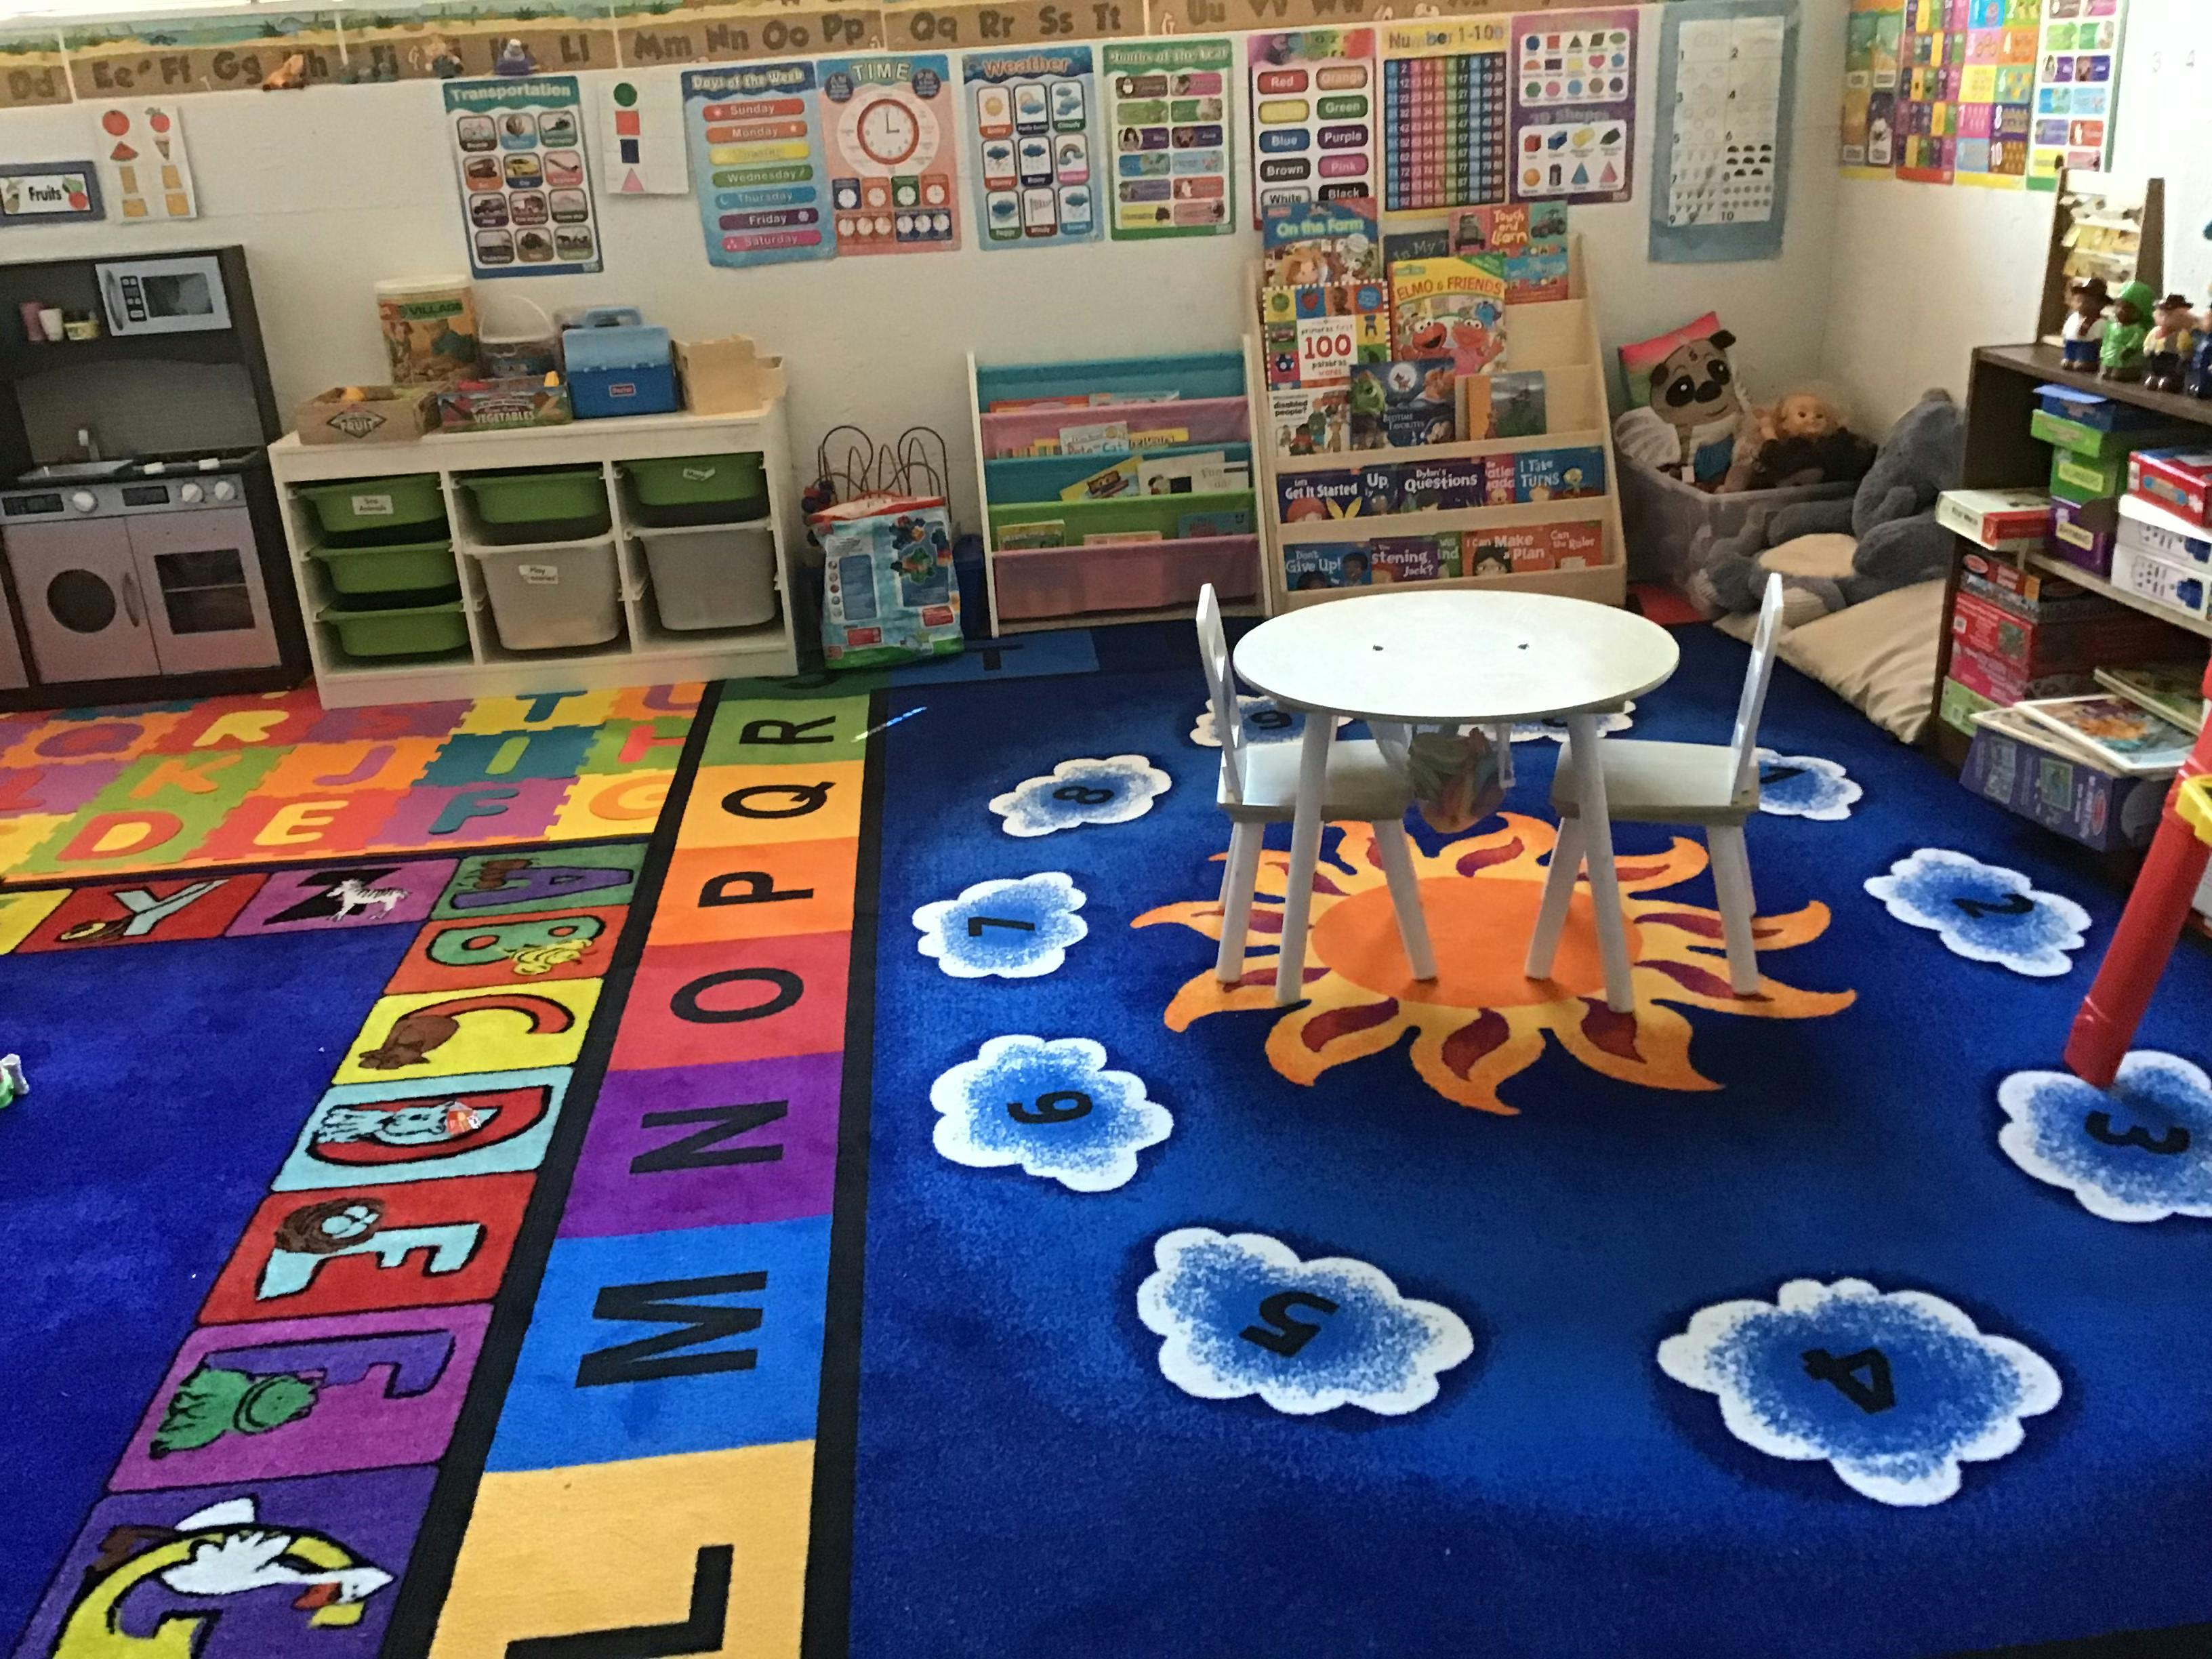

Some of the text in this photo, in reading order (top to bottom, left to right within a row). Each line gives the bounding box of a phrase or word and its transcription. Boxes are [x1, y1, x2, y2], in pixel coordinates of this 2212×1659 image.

[910, 12, 959, 43] Qq
[979, 9, 1014, 40] Rr
[1038, 5, 1074, 35] Ss
[634, 12, 865, 61] Mm Nn Oo Pp
[91, 60, 134, 89] Ee
[212, 50, 262, 85] Gg
[851, 63, 911, 81] TIME
[983, 57, 1071, 77] Weather
[693, 68, 804, 89] Days of the Week
[1271, 76, 1294, 87] Red
[1322, 73, 1365, 85] Orange
[451, 83, 571, 101] Transportation
[730, 104, 775, 116] Sunday
[1325, 102, 1361, 113] Green
[732, 126, 779, 138] Monday
[1324, 131, 1363, 144] Purple
[1271, 136, 1298, 147] Blue
[1267, 165, 1304, 177] Brown
[1330, 161, 1356, 173] Pink
[726, 170, 796, 183] Wednesday
[28, 185, 62, 202] Fruits
[738, 192, 793, 203] Thursday
[1269, 193, 1302, 204] White
[1328, 186, 1360, 199] Black
[749, 213, 787, 226] Friday
[1494, 209, 1525, 223] Touch
[1721, 211, 1734, 222] 10
[1277, 218, 1364, 237] On the Farm
[1498, 221, 1519, 231] and
[745, 234, 798, 247] Saturday
[1414, 240, 1437, 255] My
[1397, 280, 1433, 301] ELMO
[1447, 276, 1503, 295] FRIENDS
[1304, 333, 1351, 360] 100
[1312, 359, 1347, 370] palabras
[474, 411, 535, 425] VEGETABLES
[1275, 407, 1307, 417] people?
[340, 417, 375, 432] FRUIT
[1520, 460, 1524, 473] I
[1285, 487, 1304, 499] Get
[1307, 485, 1315, 497] It
[1317, 483, 1358, 498] Started
[1404, 474, 1478, 494] Questions
[1472, 537, 1491, 547] Can
[1494, 534, 1534, 548] Make
[1550, 529, 1570, 540] Can
[1295, 550, 1319, 560] Don't
[1371, 549, 1432, 565] stening,
[1513, 548, 1545, 560] Plan
[529, 567, 546, 575] Play
[1286, 557, 1341, 575] Give Up!
[1404, 564, 1435, 578] Jack?
[192, 710, 290, 747] R
[514, 689, 588, 723] T
[739, 715, 836, 745] R
[129, 754, 244, 800] K
[312, 744, 396, 787] J
[485, 736, 531, 775] I
[721, 781, 836, 819] Q
[1052, 785, 1115, 806] 8
[54, 809, 184, 861] D
[251, 800, 350, 846] E
[428, 787, 520, 835] F
[698, 870, 815, 908] P
[1951, 893, 2036, 919] 2
[968, 915, 1036, 938] 7
[670, 966, 805, 1025] O
[630, 1100, 789, 1174] N
[2084, 1109, 2191, 1155] 3
[575, 1269, 769, 1388] M
[1238, 1291, 1342, 1357] 5
[1801, 1345, 1896, 1414] 4
